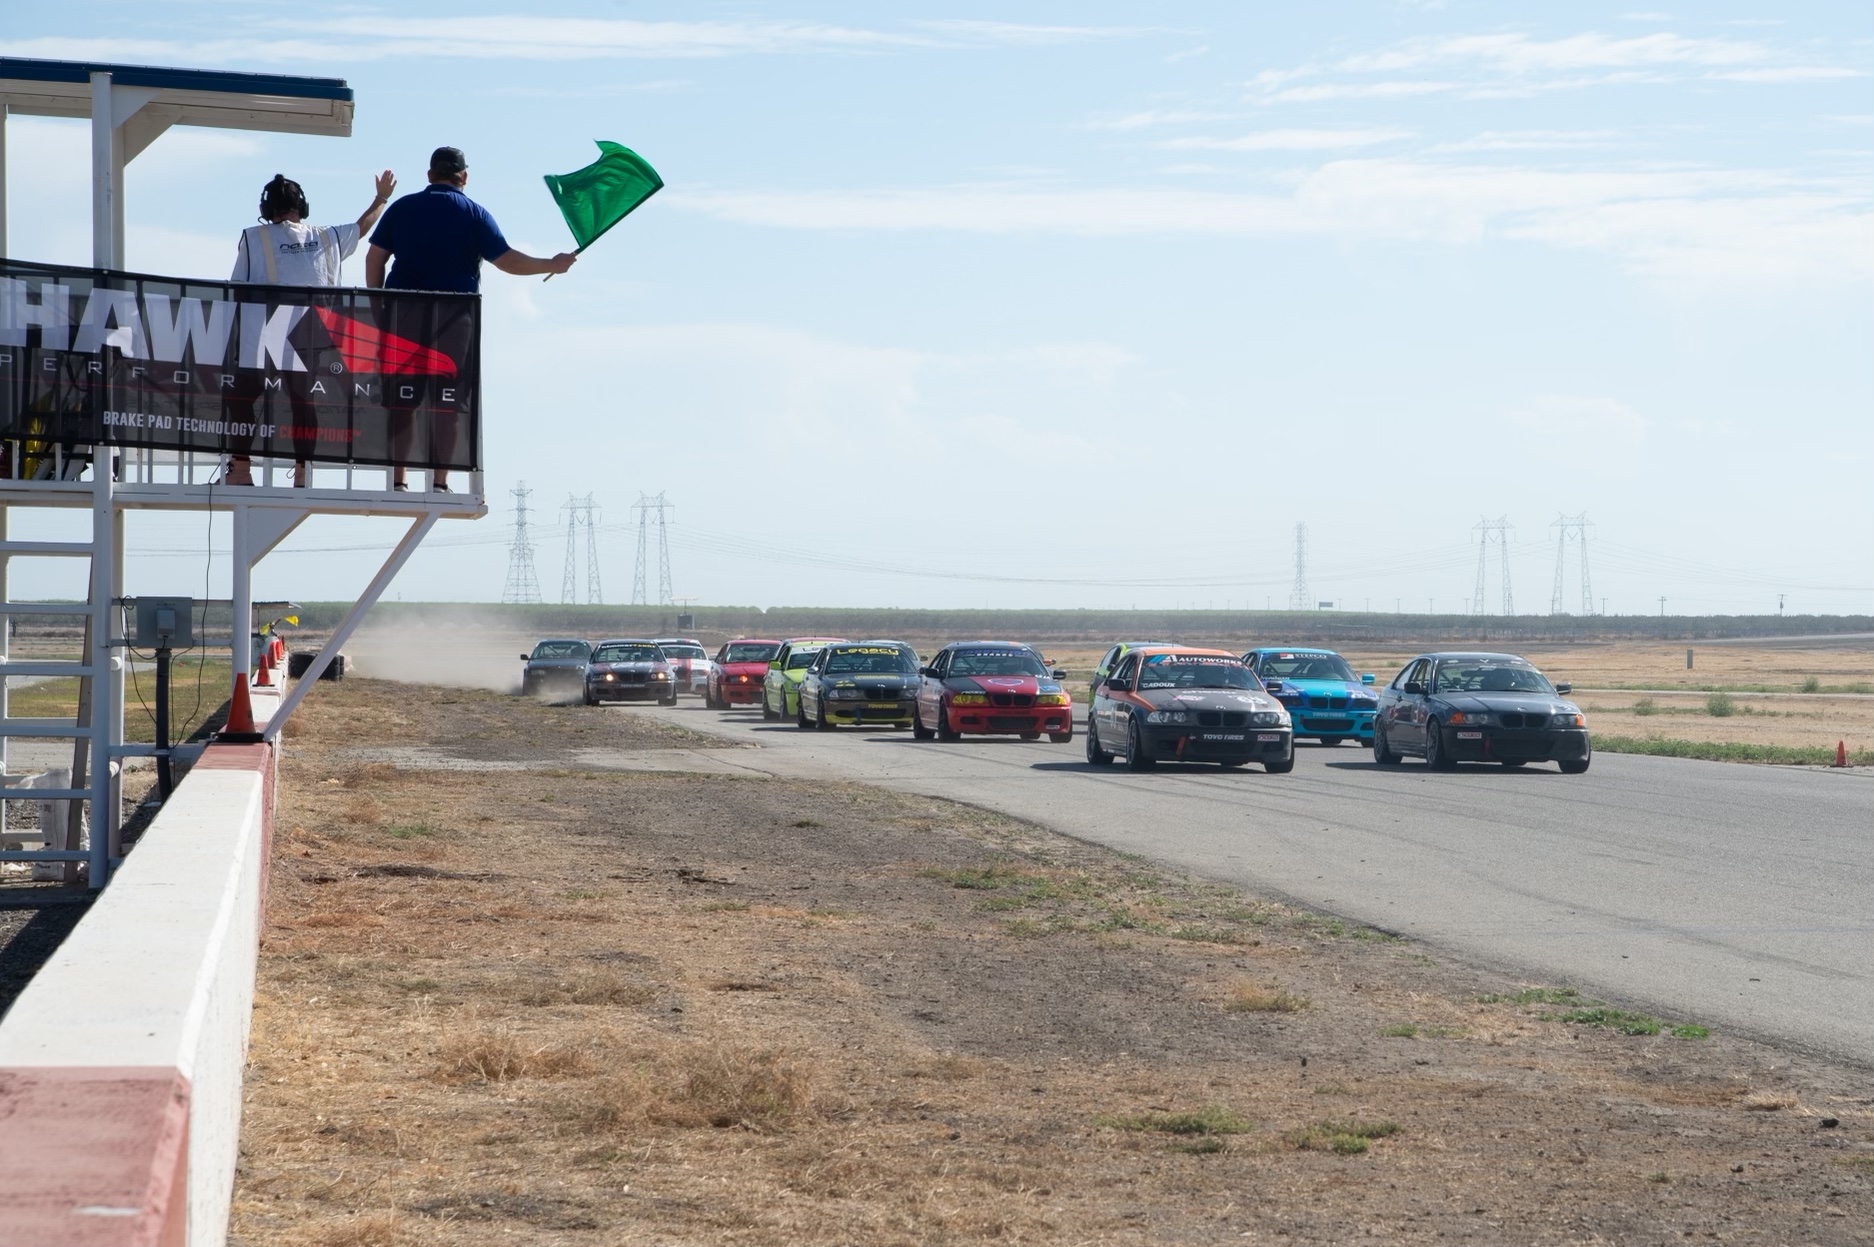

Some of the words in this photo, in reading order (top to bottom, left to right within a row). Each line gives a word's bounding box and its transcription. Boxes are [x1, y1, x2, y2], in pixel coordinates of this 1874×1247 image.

[0, 276, 310, 372] HAWK
[0, 353, 457, 402] PERFORMANCE
[102, 410, 144, 428] BRAKE
[148, 414, 172, 430] PAD
[176, 416, 257, 437] TECHNOLOGY
[260, 424, 276, 438] OF
[1178, 656, 1242, 666] AUTOWORKS
